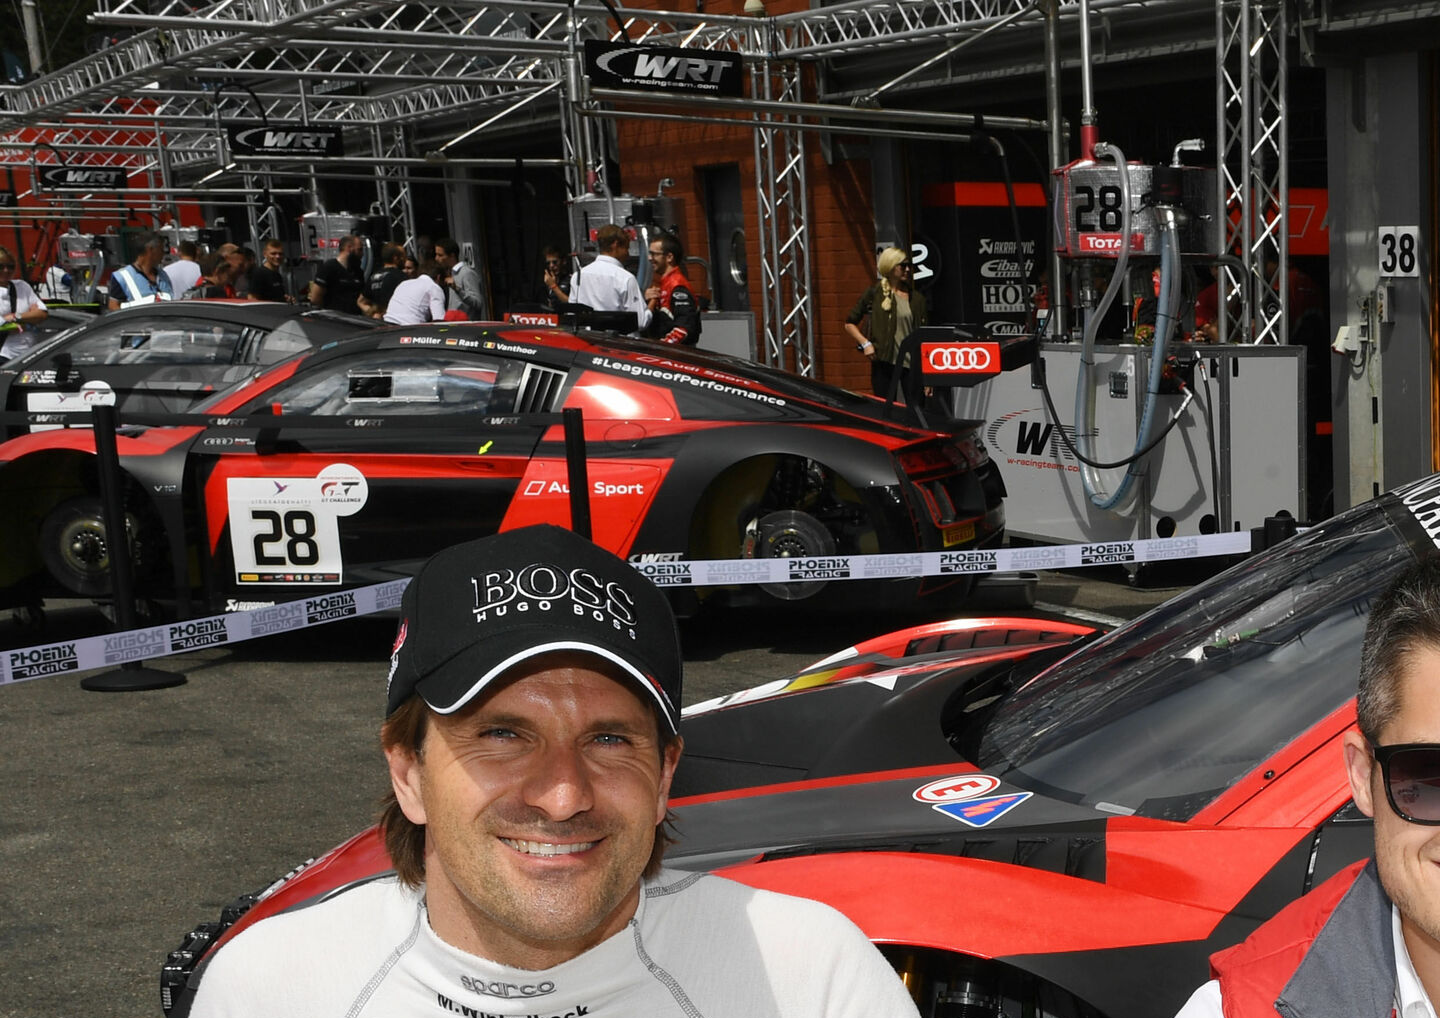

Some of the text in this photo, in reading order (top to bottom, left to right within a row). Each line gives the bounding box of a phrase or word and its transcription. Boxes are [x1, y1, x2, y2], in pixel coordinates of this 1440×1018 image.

[633, 53, 733, 83] WRT
[622, 77, 719, 91] w-racingteam.com
[262, 130, 337, 149] WRT
[66, 169, 122, 183] WRT
[1075, 185, 1123, 232] 28
[1381, 233, 1415, 274] 38
[513, 314, 557, 326] TOTAL
[412, 336, 537, 355] Müller Rast Vanthoor
[660, 360, 700, 374] Audi
[591, 356, 787, 407] #LeagueofPerformance
[1007, 458, 1080, 472] w-racingteam.co
[594, 482, 644, 496] Sport
[251, 510, 319, 566] 28
[640, 552, 684, 563] WRT
[471, 563, 638, 626] BOSS
[476, 601, 637, 640] HUGO BOSS
[10, 644, 77, 667] PHOENIX
[460, 974, 557, 998] sparco
